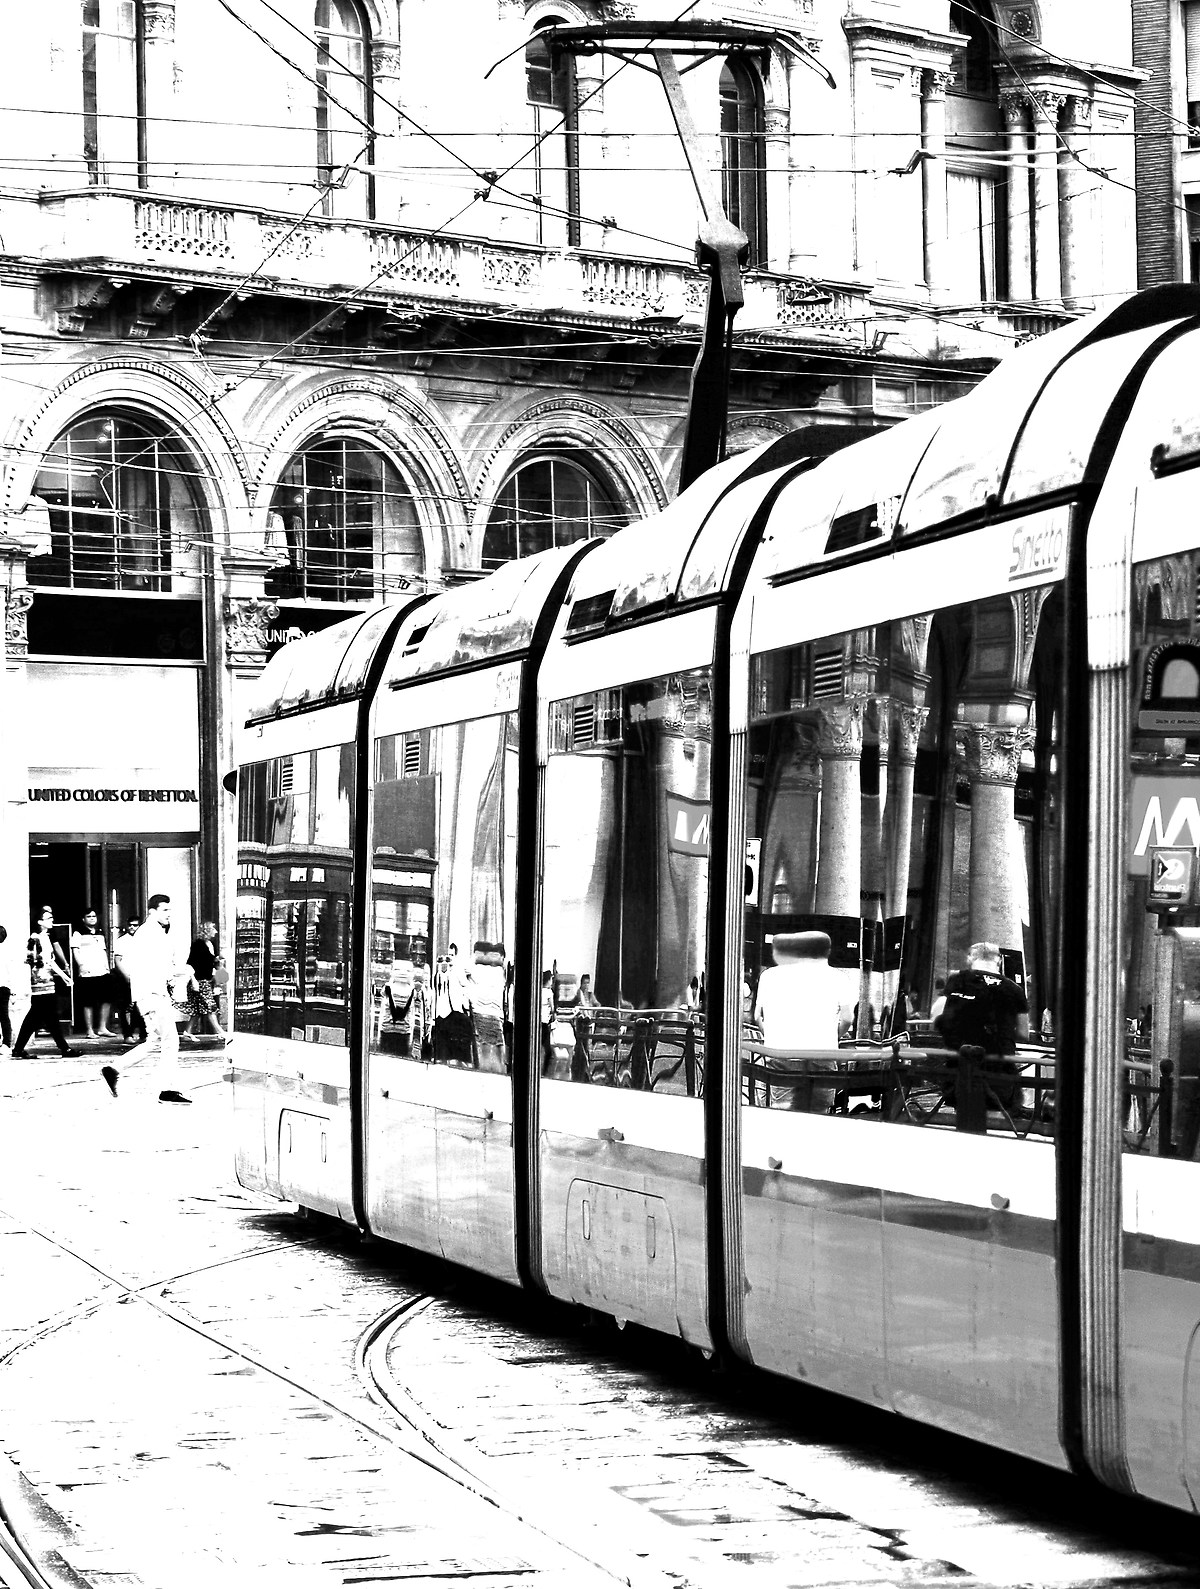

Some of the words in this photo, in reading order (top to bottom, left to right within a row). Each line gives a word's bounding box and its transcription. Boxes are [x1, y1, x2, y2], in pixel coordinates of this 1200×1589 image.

[265, 628, 306, 643] UNIT
[28, 788, 72, 801] UNITED
[73, 789, 119, 802] COLORS
[120, 789, 138, 802] OF
